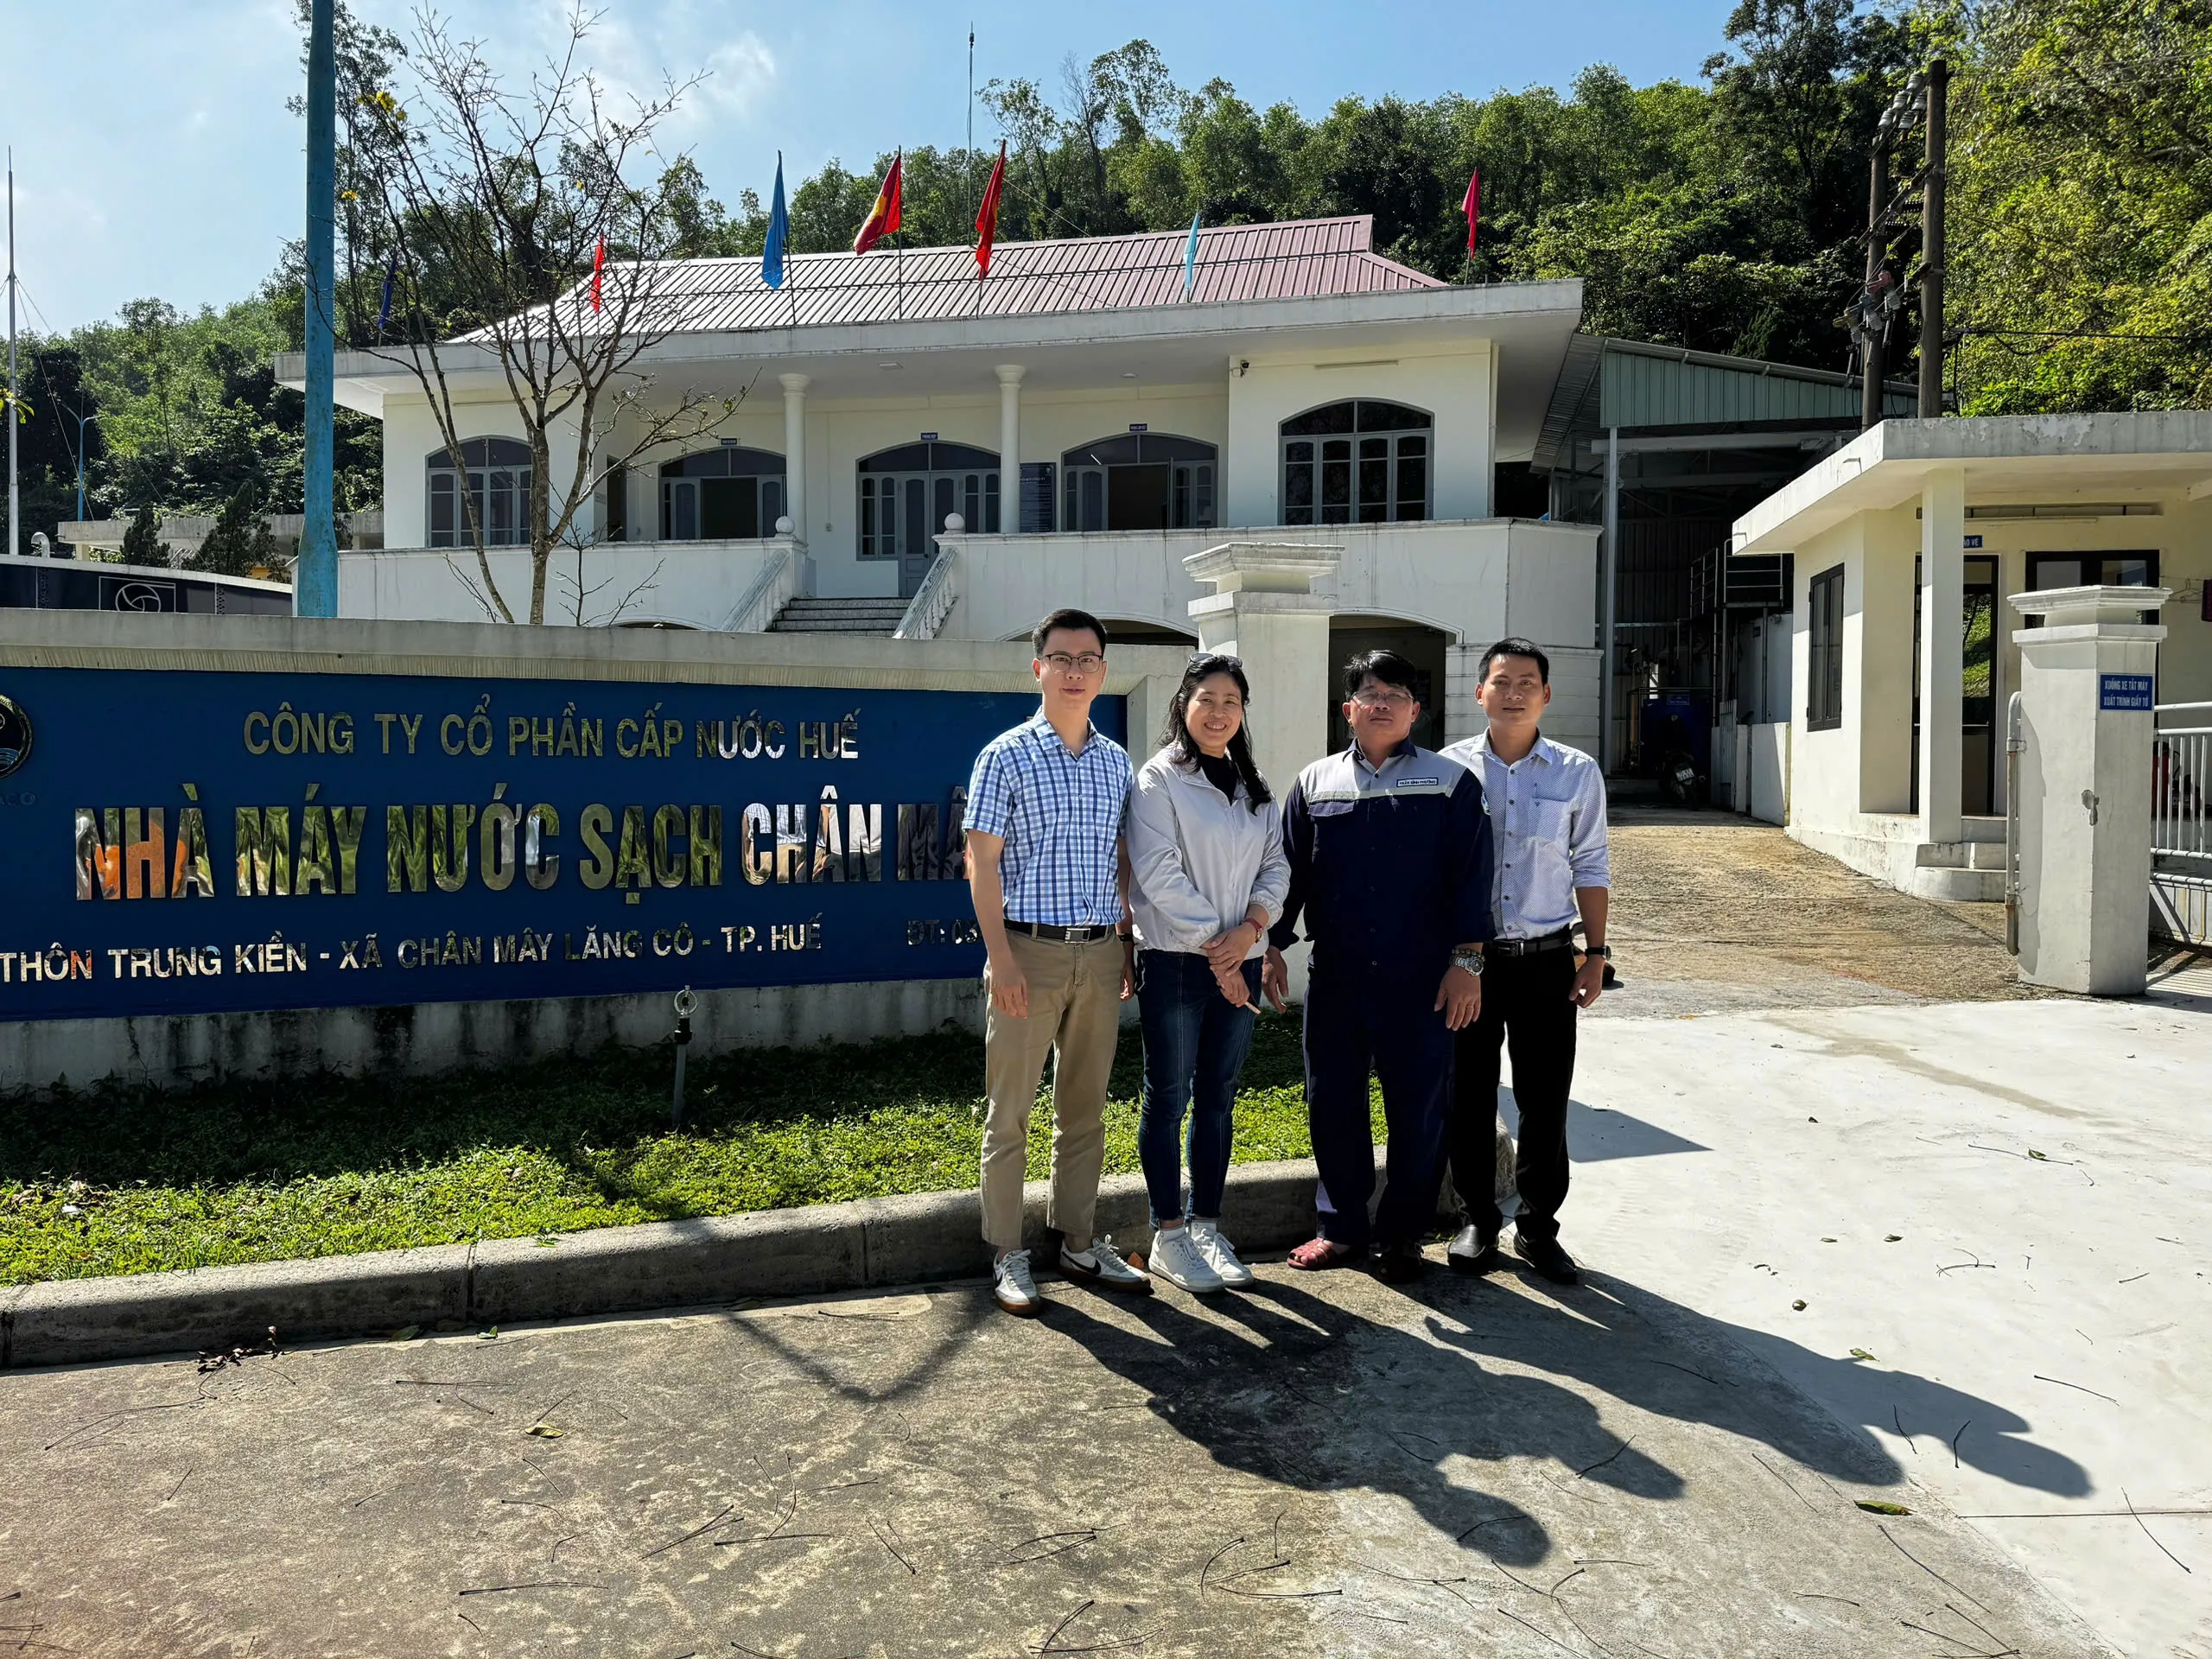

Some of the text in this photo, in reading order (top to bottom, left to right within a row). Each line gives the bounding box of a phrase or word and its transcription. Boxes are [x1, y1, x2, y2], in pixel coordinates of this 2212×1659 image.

[2121, 680, 2128, 690] XE
[244, 693, 861, 759] CÔNG TY CỔ PHẦN CẤP NƯỚC HUẾ
[75, 783, 969, 905] NHÀ MÁY NƯỚC SẠCH CHÂN MÂ
[0, 942, 92, 982] THÔN
[108, 945, 221, 979] TRUNG
[235, 931, 307, 974] KIỀN
[340, 933, 383, 969] XÃ
[397, 931, 481, 969] CHÂN
[493, 927, 553, 963] MÂY
[565, 925, 643, 960] LĂNG
[652, 922, 693, 957] CÔ
[721, 926, 762, 953] TP.
[772, 912, 822, 951] HUẾ
